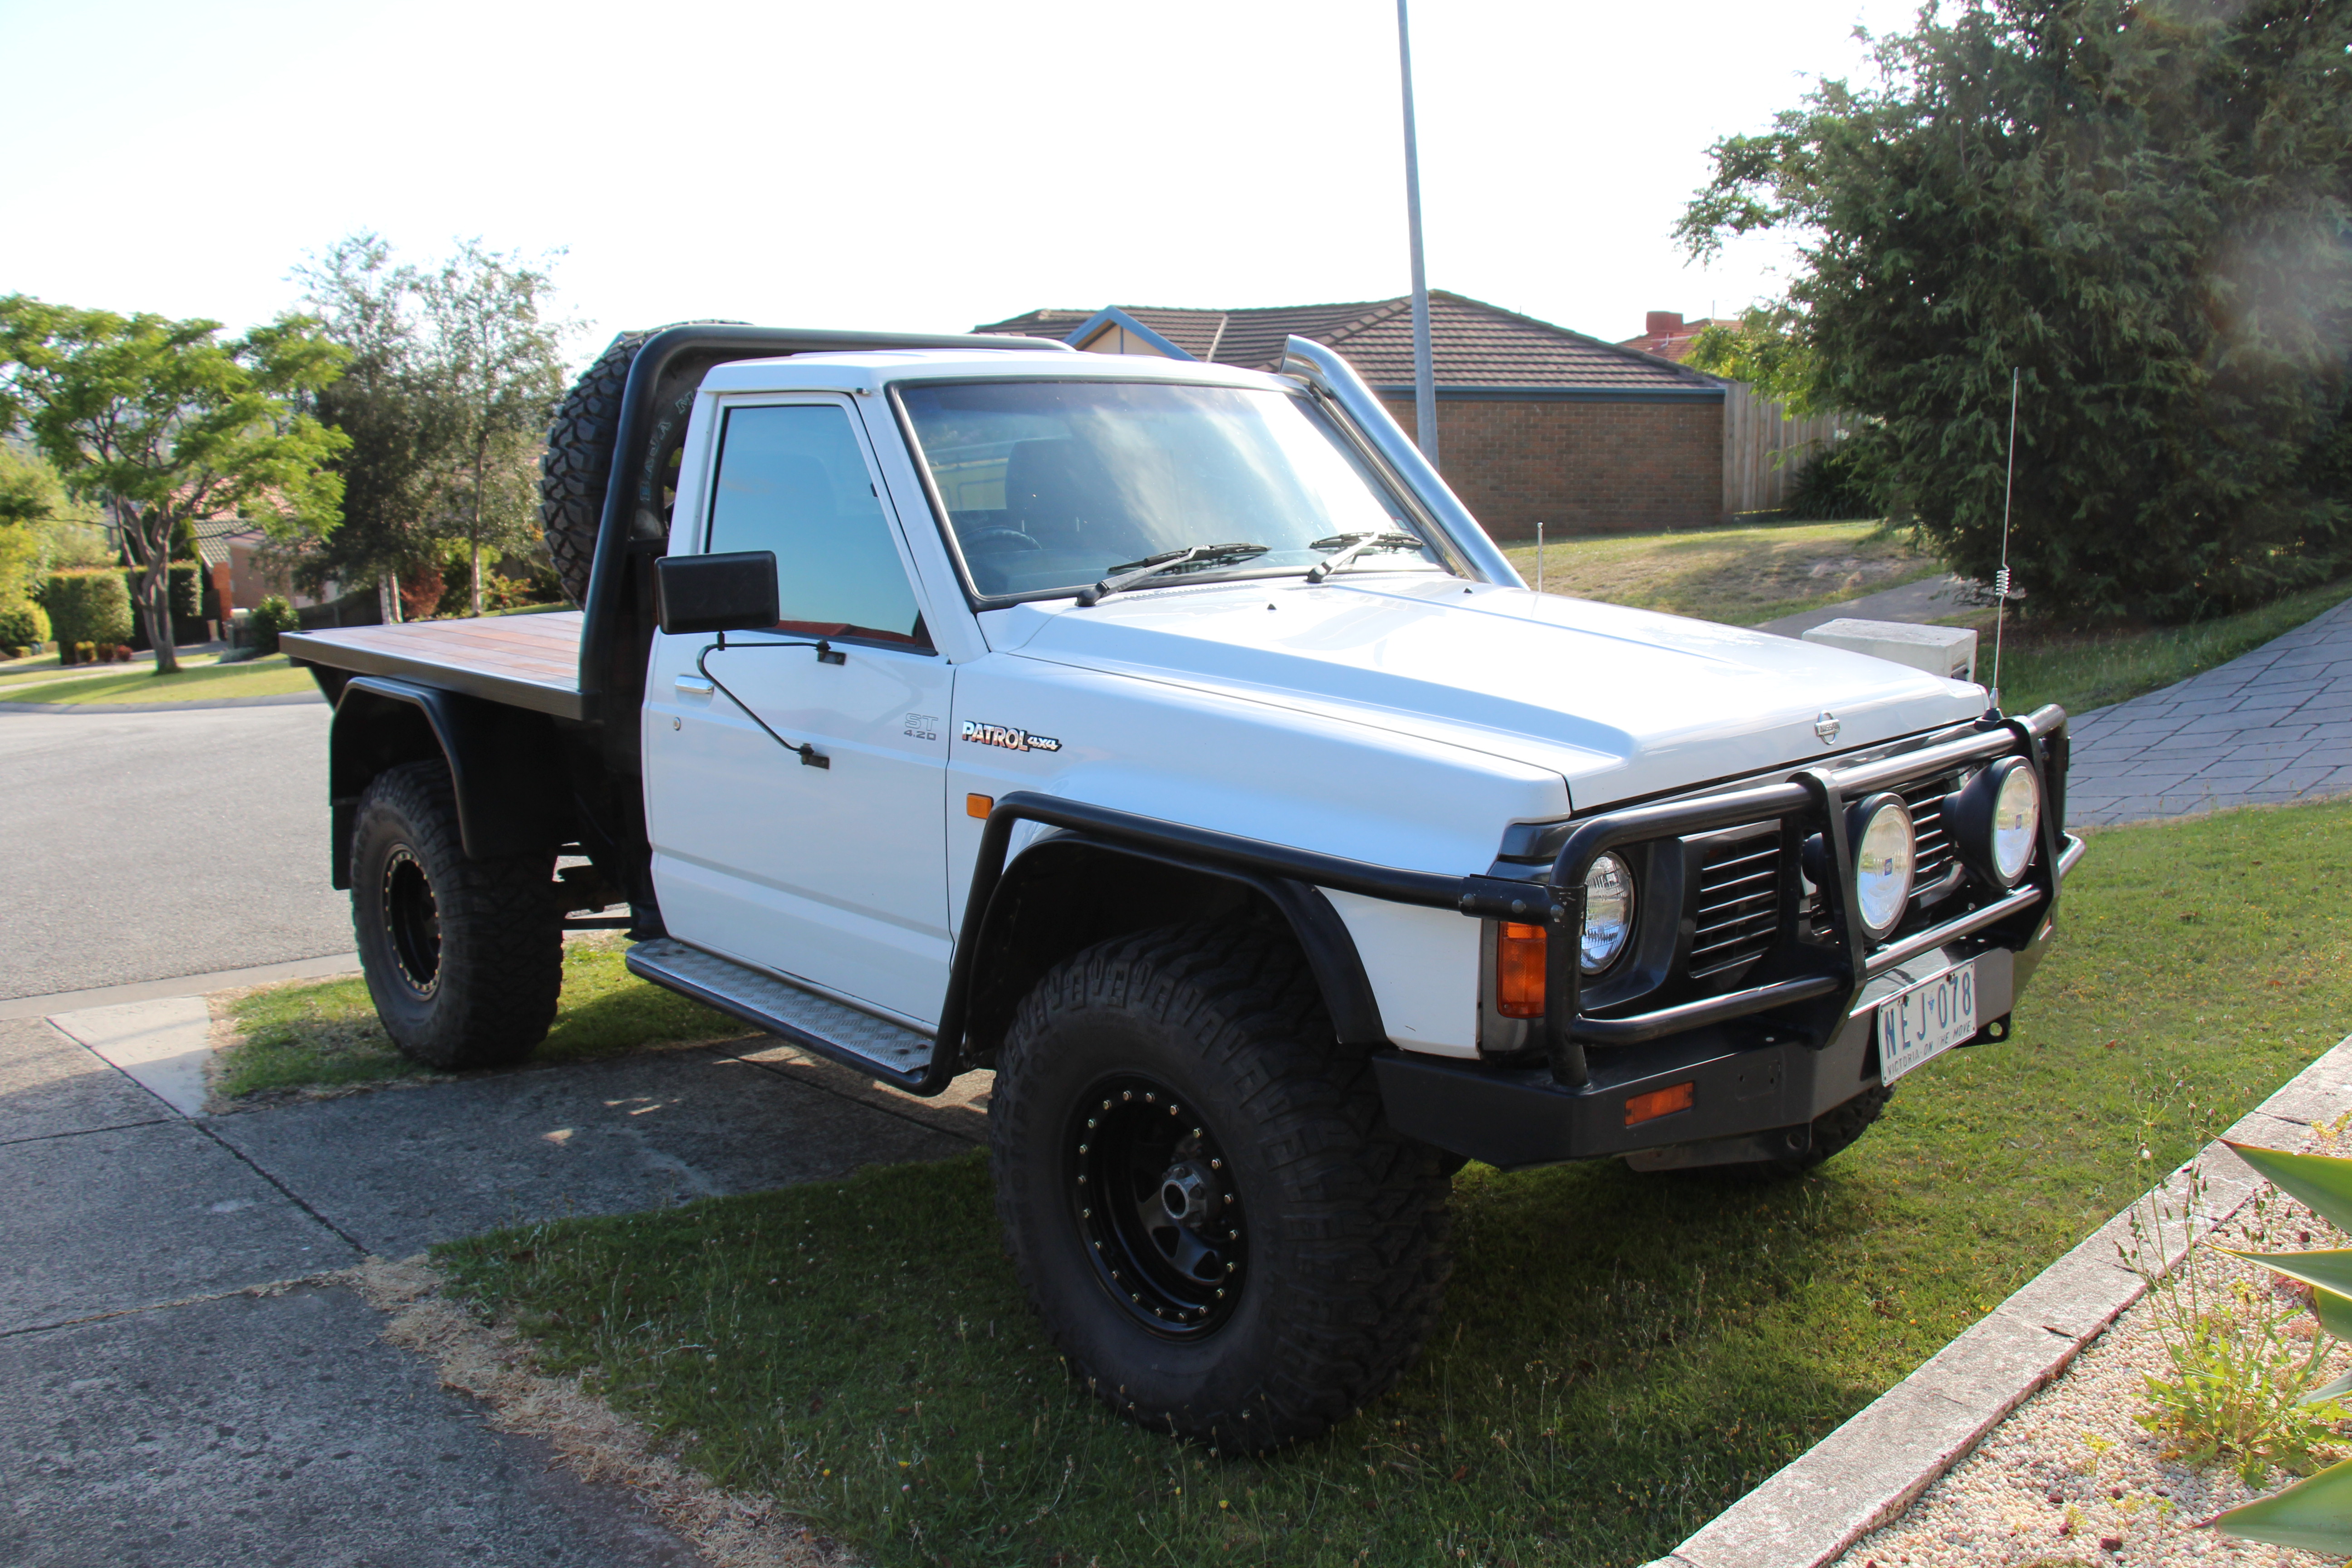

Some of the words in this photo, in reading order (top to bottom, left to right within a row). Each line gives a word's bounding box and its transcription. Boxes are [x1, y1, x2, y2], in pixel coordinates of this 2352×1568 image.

[640, 421, 672, 501] BAJA
[905, 713, 939, 731] ST
[904, 729, 936, 741] 4.2D
[962, 720, 1029, 752] PATROL
[1885, 992, 1926, 1059] NEJ
[1937, 971, 1971, 1029] 078
[1953, 1020, 1971, 1039] MOVE
